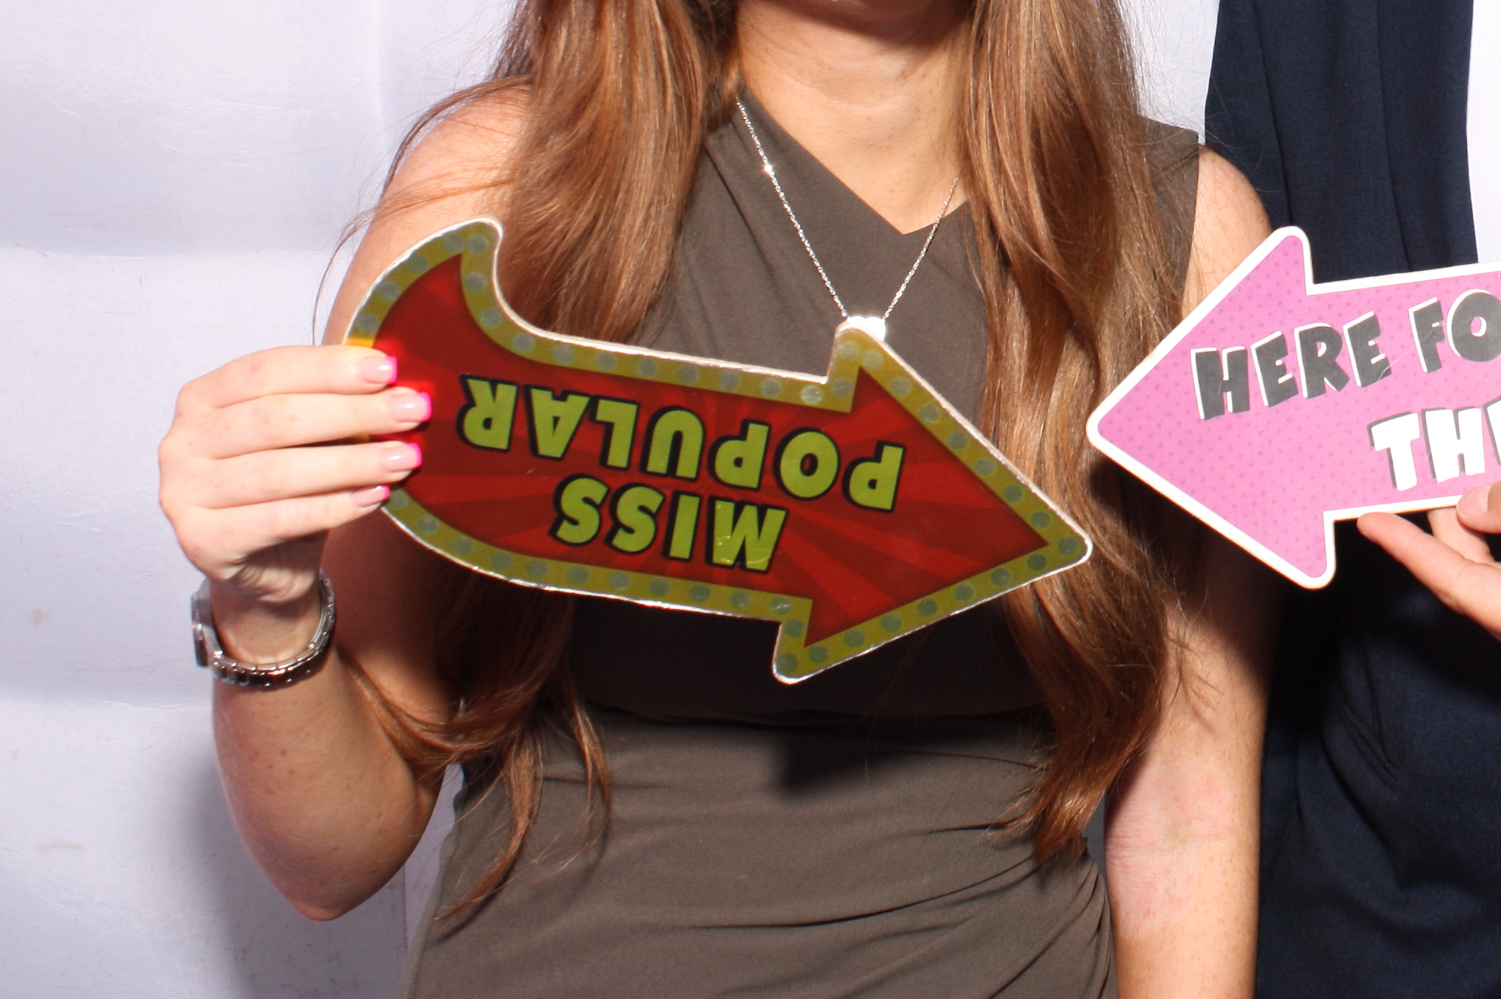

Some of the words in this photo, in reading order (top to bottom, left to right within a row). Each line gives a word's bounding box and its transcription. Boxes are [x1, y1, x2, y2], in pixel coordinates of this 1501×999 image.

[1190, 311, 1393, 420] HERE
[455, 373, 906, 513] POPULAR
[549, 474, 790, 573] MISS
